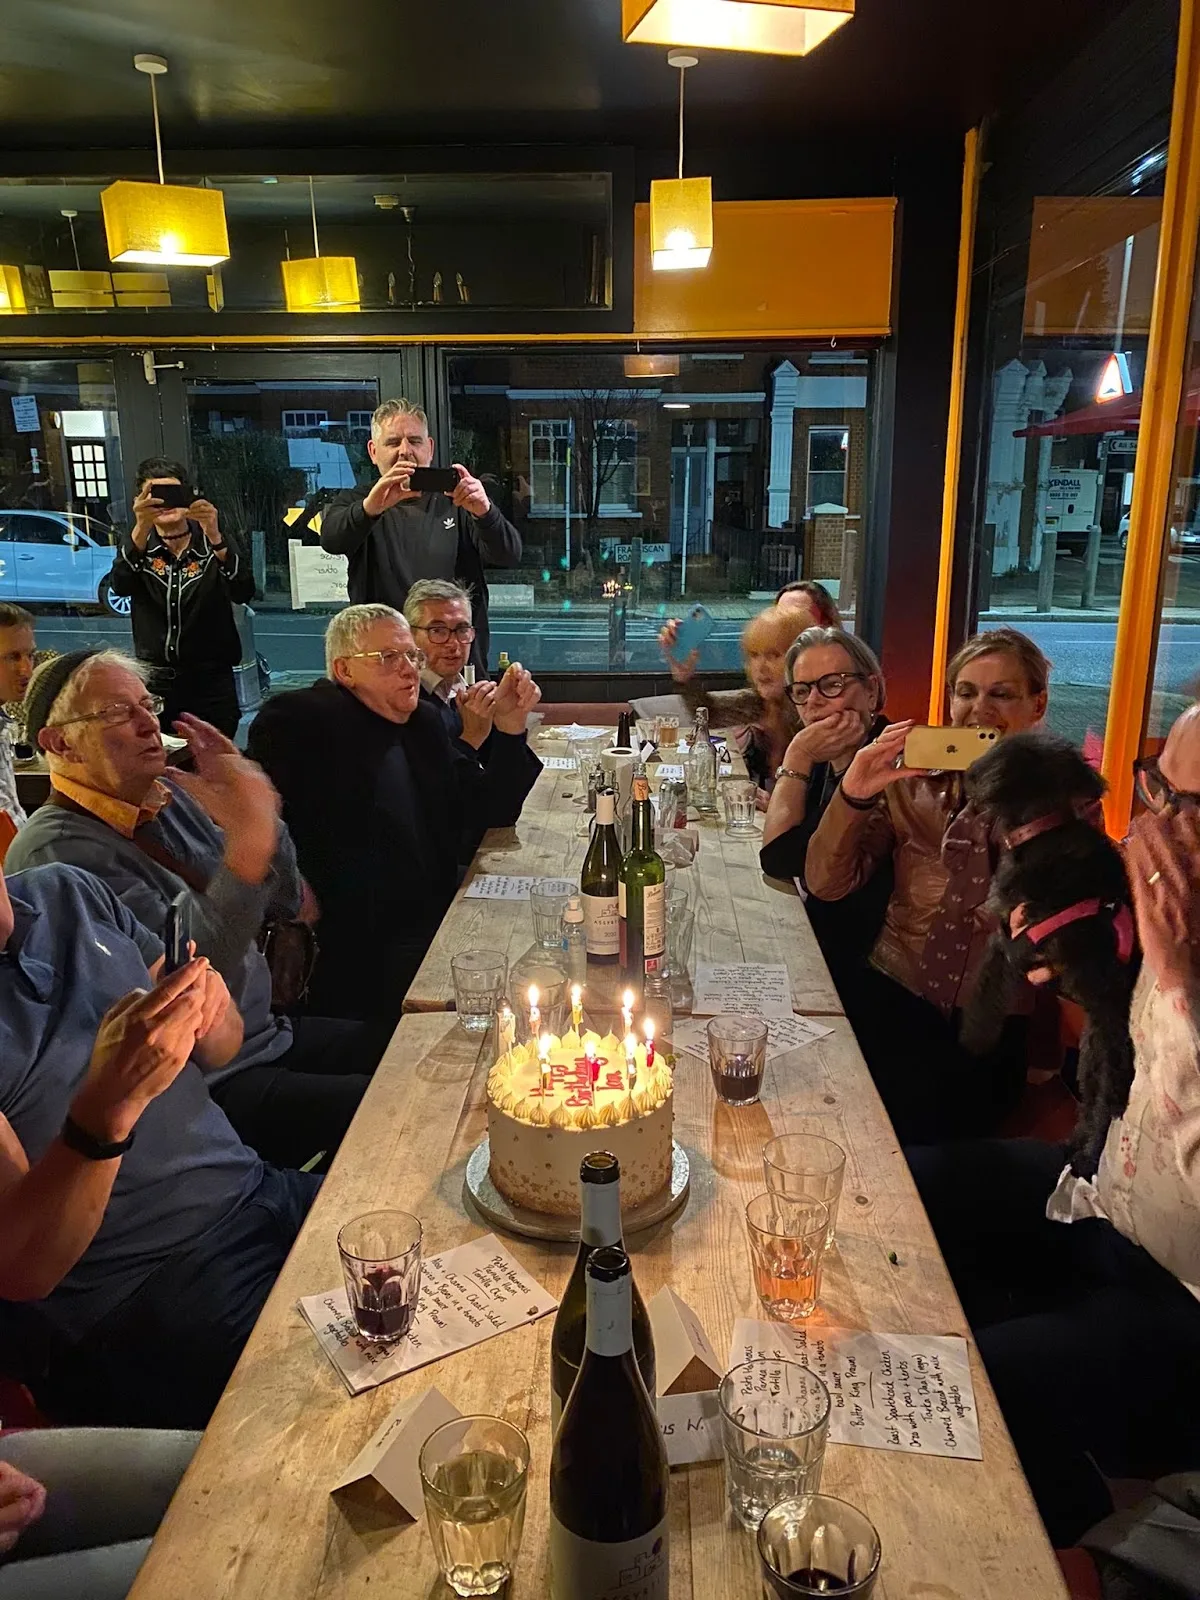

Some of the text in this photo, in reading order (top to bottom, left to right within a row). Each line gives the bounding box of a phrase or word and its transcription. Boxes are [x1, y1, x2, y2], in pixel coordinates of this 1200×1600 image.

[1048, 479, 1081, 487] KENDALL
[617, 545, 665, 554] FRAISCAN
[491, 1255, 508, 1273] Pesto
[472, 1267, 507, 1303] Tortilla Chips
[502, 1282, 517, 1296] Ham
[428, 1309, 448, 1329] Prawns
[845, 1356, 857, 1379] Prawns
[880, 1350, 893, 1377] Chicken
[896, 1360, 910, 1382] herbs
[740, 1375, 753, 1396] Pesto
[848, 1381, 866, 1398] King
[904, 1391, 917, 1408] peas
[949, 1385, 971, 1419] vegetables
[885, 1425, 900, 1445] Roast
